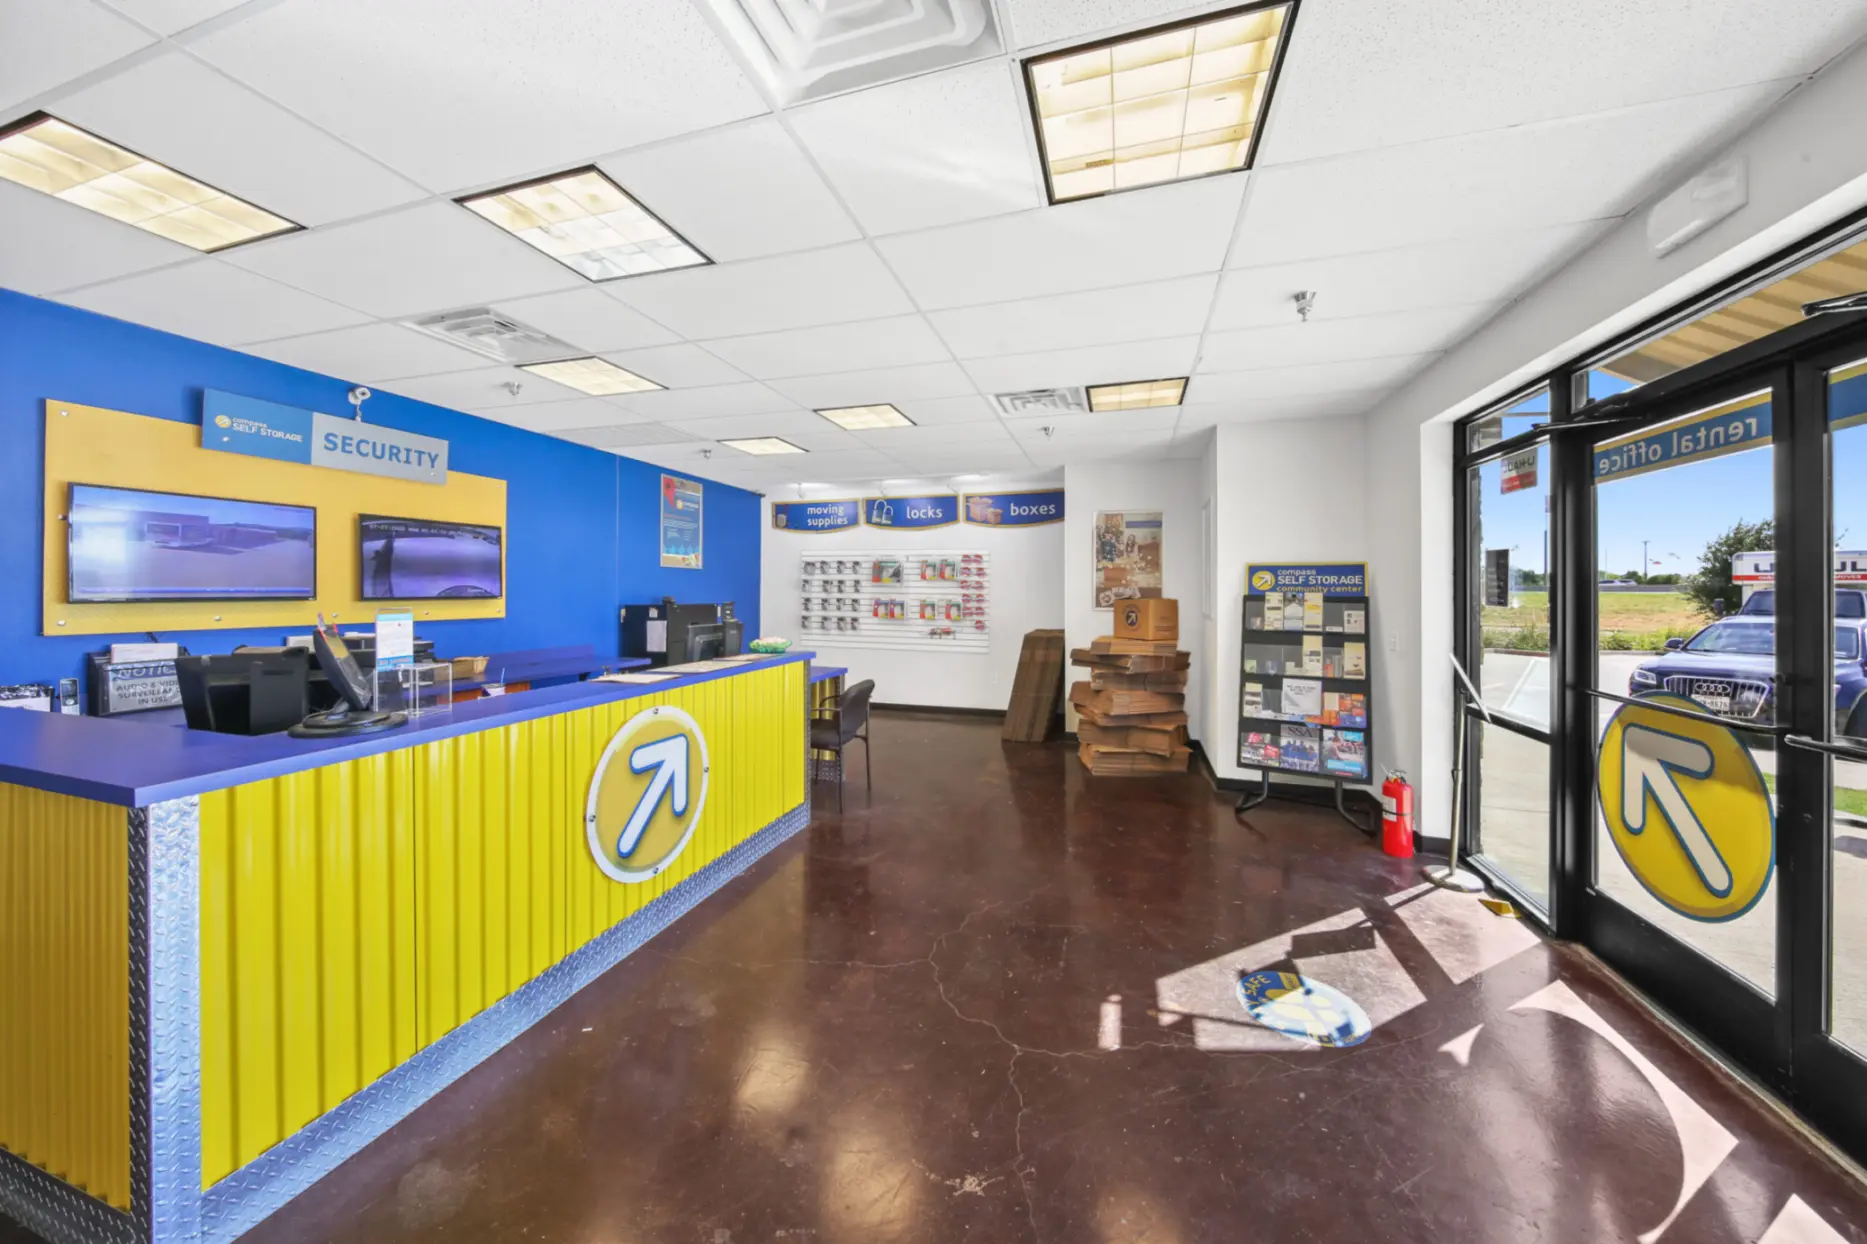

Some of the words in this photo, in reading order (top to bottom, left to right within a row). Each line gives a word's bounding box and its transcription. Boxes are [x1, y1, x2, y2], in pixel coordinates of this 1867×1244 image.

[232, 416, 268, 427] compass
[232, 422, 259, 434] SELF
[260, 428, 304, 442] STORAGE
[323, 432, 440, 469] SECURITY
[807, 504, 845, 517] moving
[906, 505, 943, 519] locks
[1010, 502, 1056, 516] boxes
[807, 515, 848, 528] supplies
[1277, 569, 1317, 578] compass
[1277, 575, 1306, 585] SELF
[1308, 575, 1363, 585] STORAGE
[1276, 585, 1328, 593] community
[118, 664, 177, 678] NOTIC
[138, 697, 149, 705] IN
